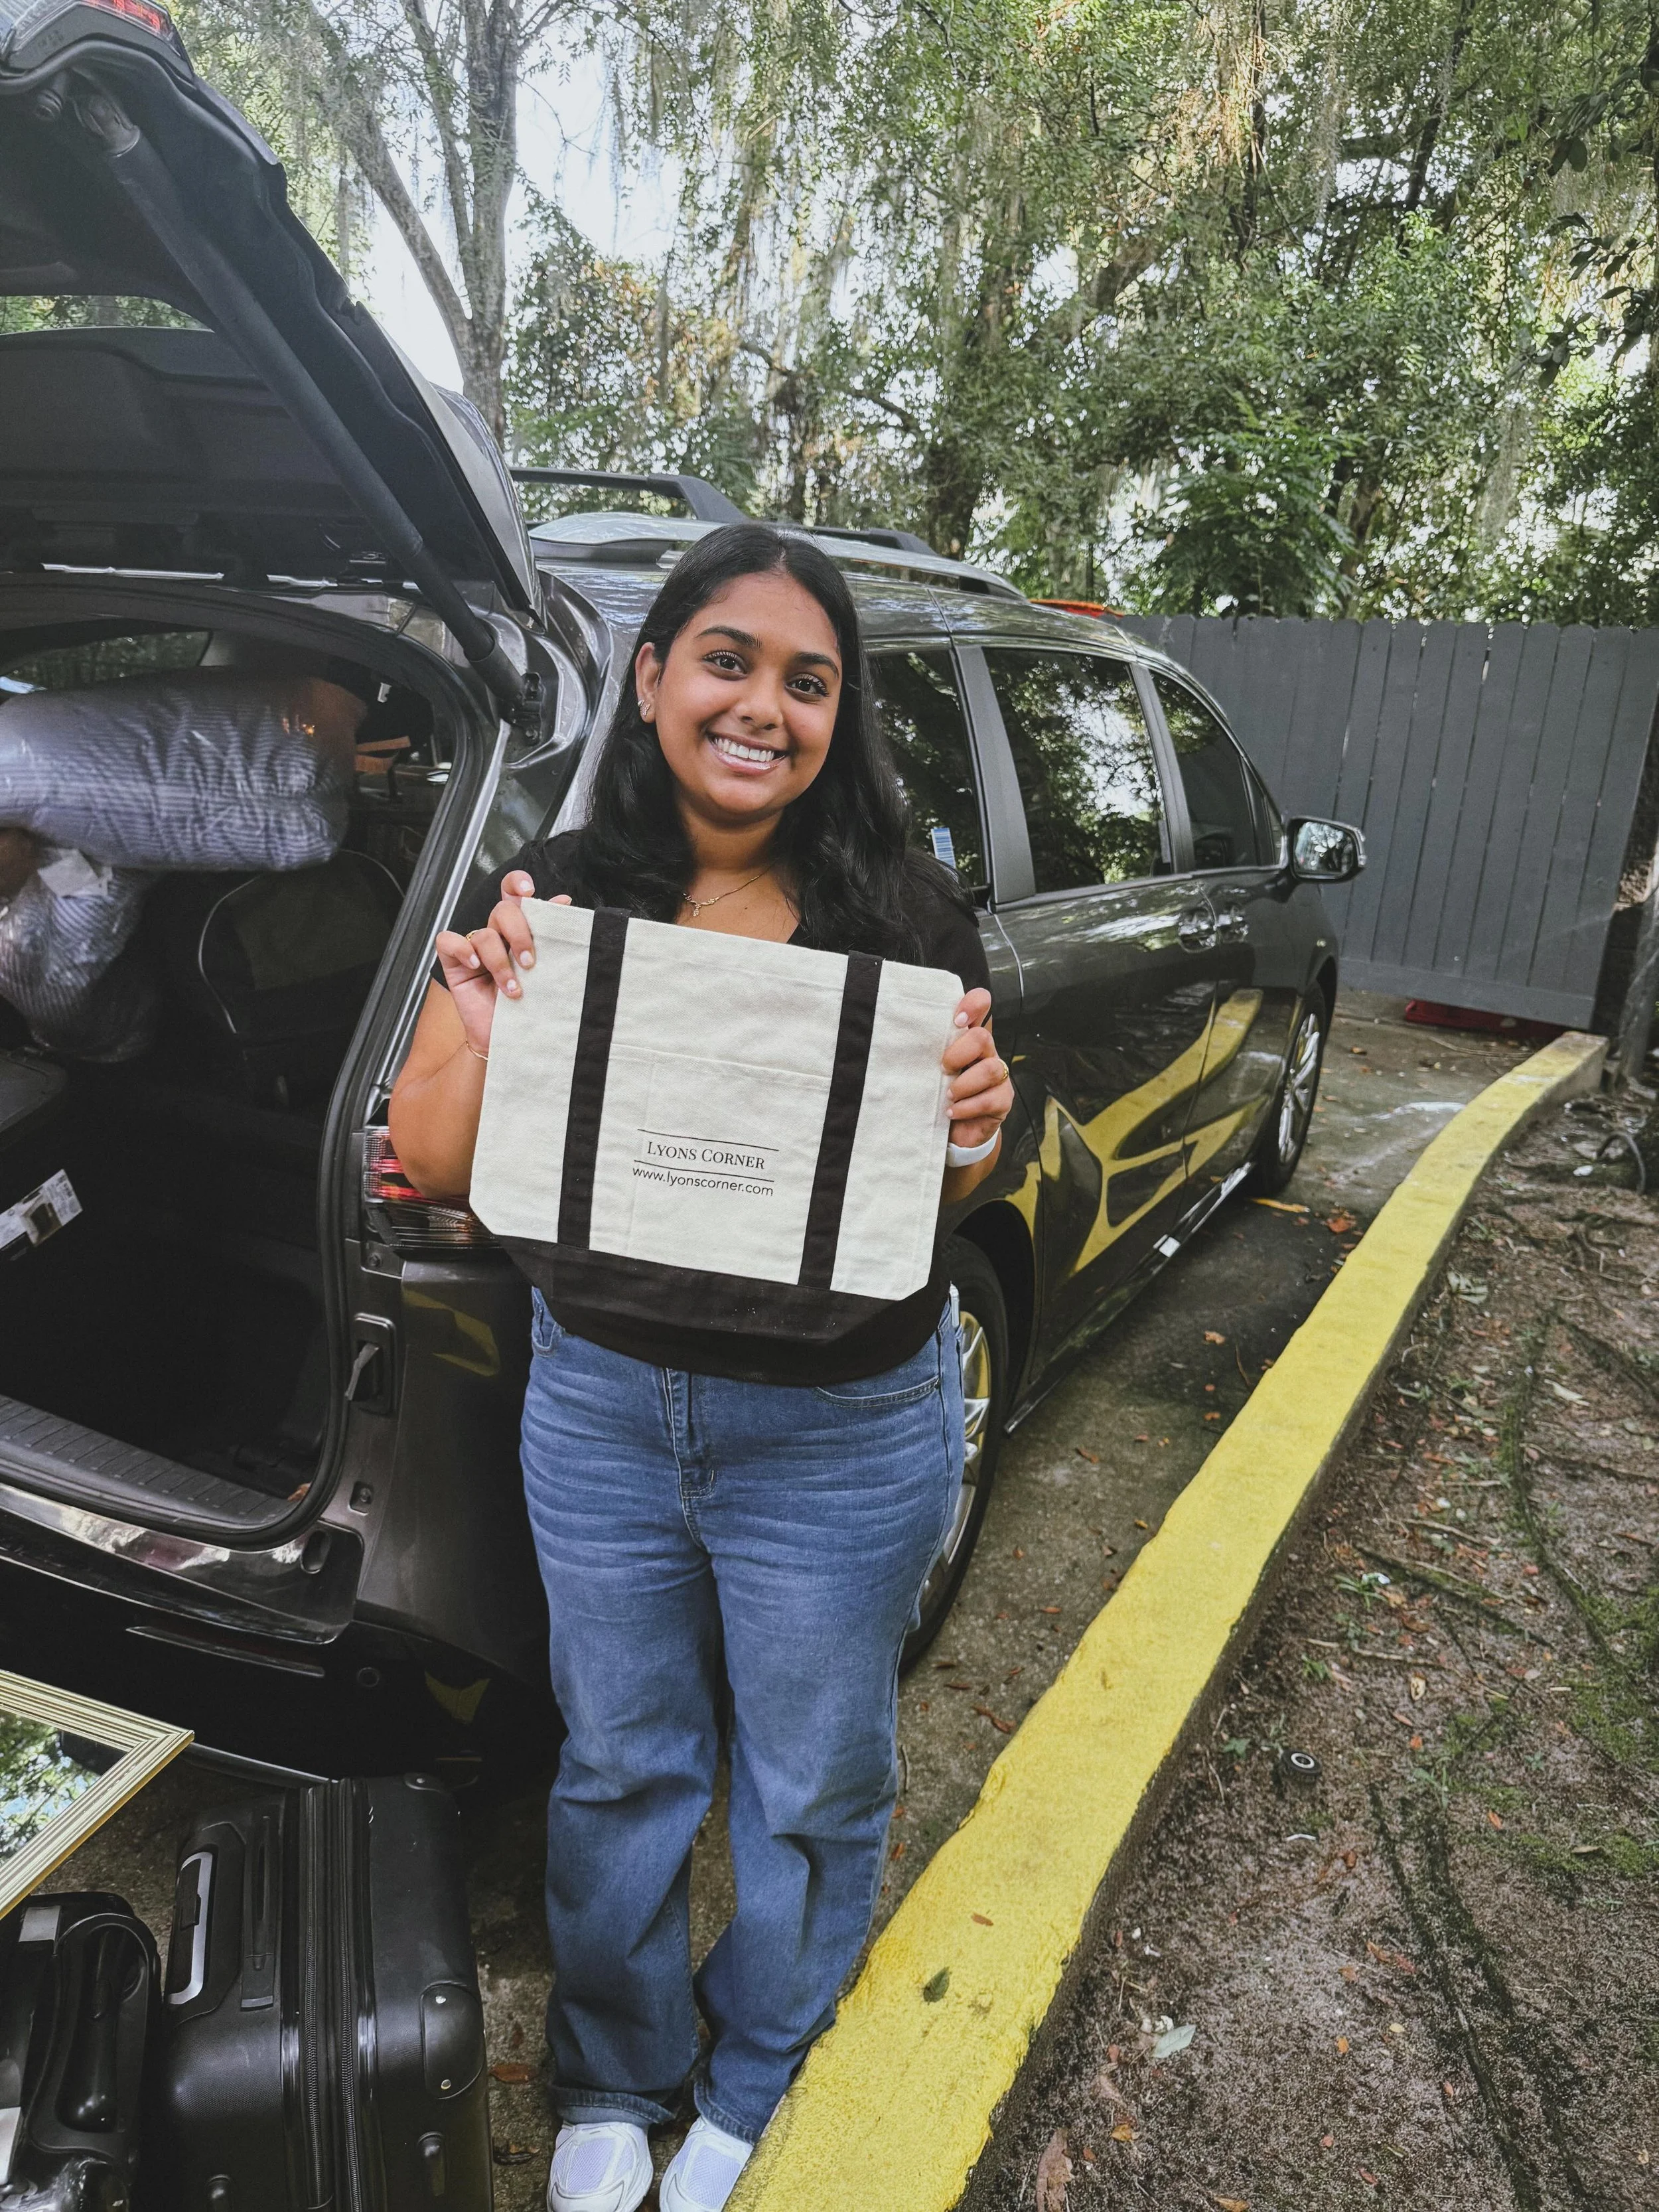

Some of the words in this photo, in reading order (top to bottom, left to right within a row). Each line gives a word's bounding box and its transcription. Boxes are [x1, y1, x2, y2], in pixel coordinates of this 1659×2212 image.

[647, 1141, 697, 1160] LYONS
[701, 1149, 764, 1169] CORNER
[632, 1167, 773, 1196] www.lyonscorner.com
